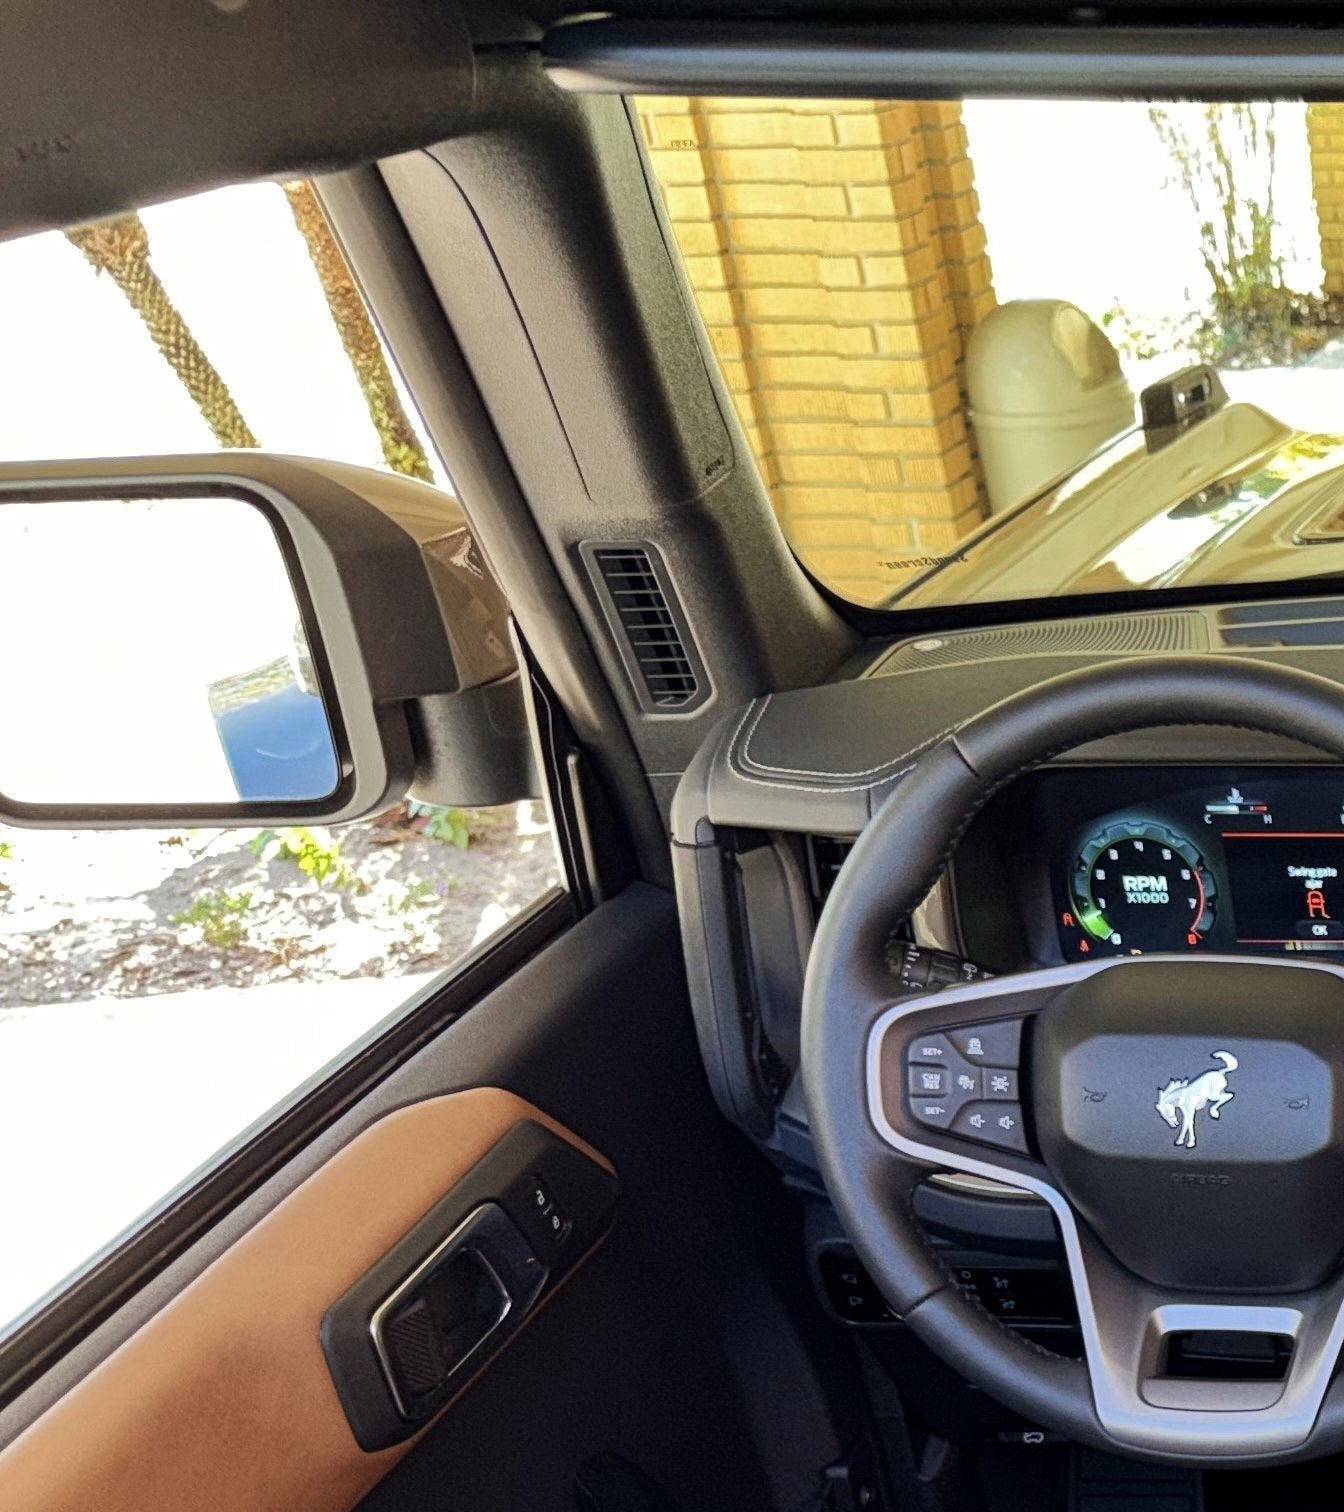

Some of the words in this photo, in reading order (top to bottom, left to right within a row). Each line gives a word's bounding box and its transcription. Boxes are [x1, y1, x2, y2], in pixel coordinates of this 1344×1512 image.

[1203, 814, 1213, 825] C
[1263, 814, 1273, 825] H
[1122, 876, 1168, 892] RPM
[1125, 892, 1170, 904] X1000
[1311, 925, 1328, 936] OK
[1110, 933, 1122, 945] 0
